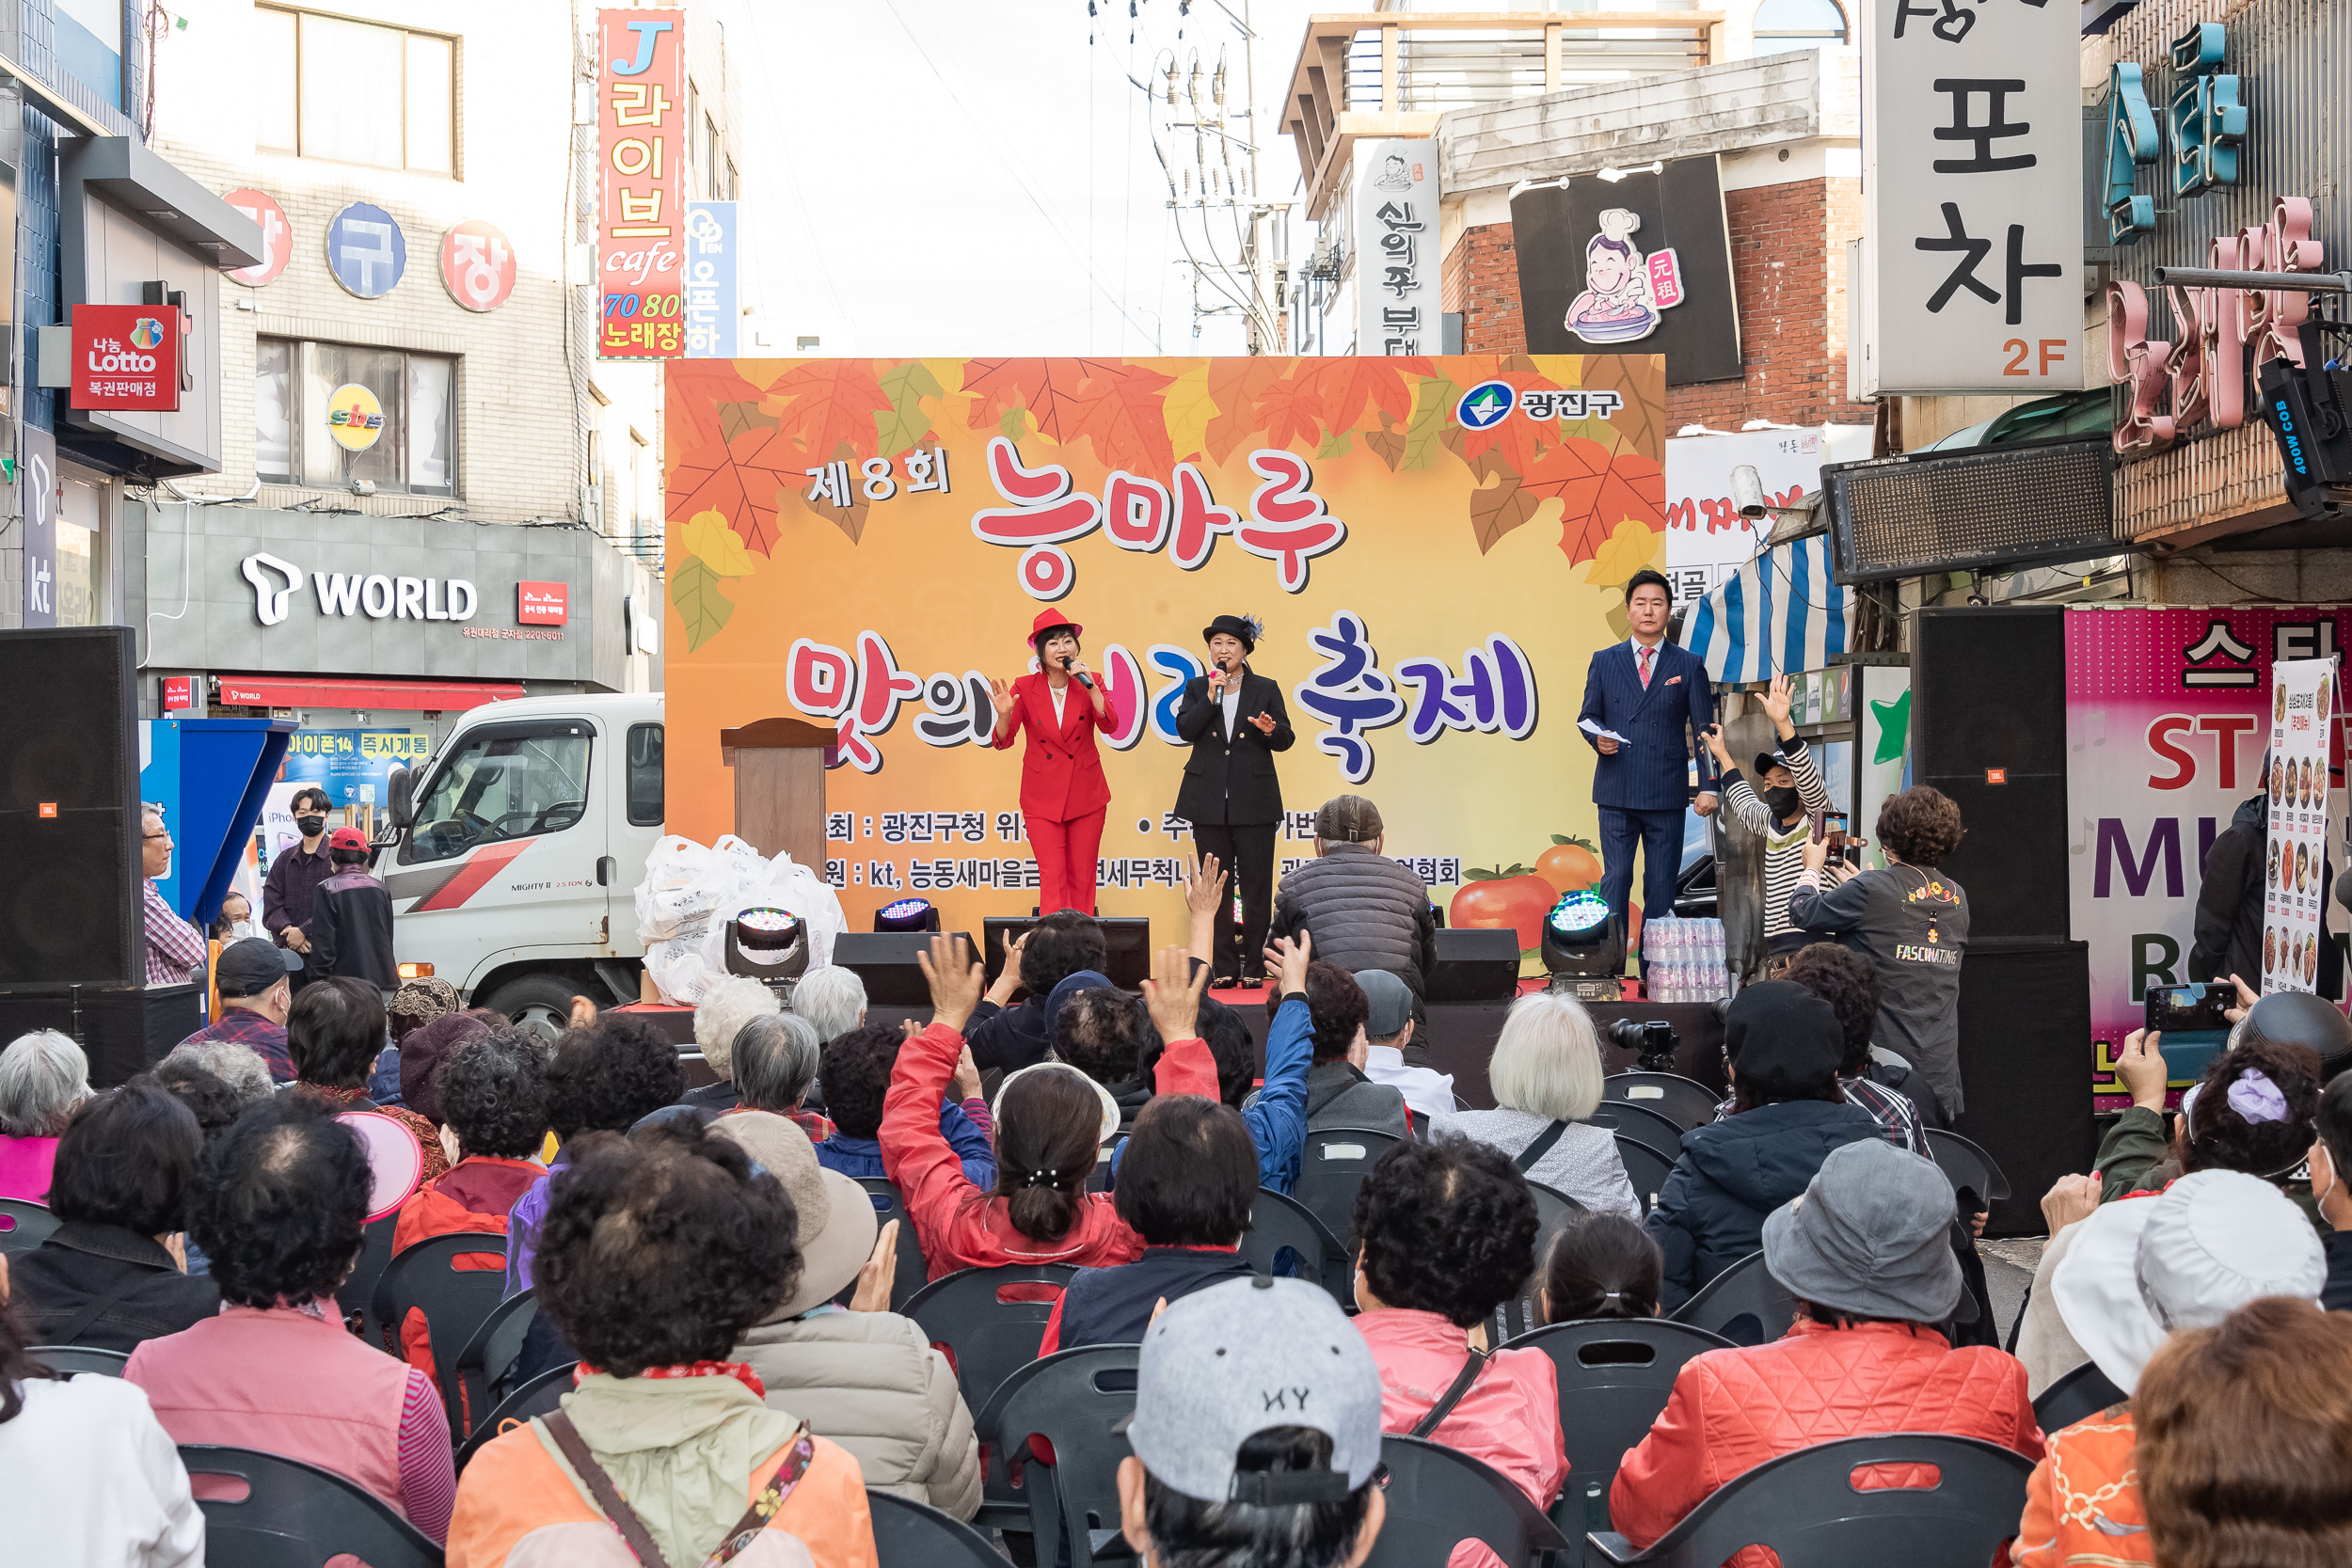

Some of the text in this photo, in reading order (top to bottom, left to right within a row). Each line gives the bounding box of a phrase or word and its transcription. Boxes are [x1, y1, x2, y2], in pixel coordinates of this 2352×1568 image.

[612, 22, 673, 75] J
[612, 83, 671, 238] 라이브
[605, 241, 678, 286] cafe
[1375, 200, 1425, 299] 신의주
[1653, 258, 1677, 302] 元祖
[690, 261, 721, 357] 오픈하
[94, 339, 121, 353] 나눔
[604, 322, 682, 351] 노래장
[88, 351, 156, 372] Lotto
[2002, 338, 2068, 376] 2F
[89, 381, 156, 396] 복권판매점
[1519, 389, 1623, 420] 광진구
[2276, 400, 2306, 474] 400W COB
[972, 437, 1347, 600] 능마루
[31, 556, 51, 614] kt
[312, 570, 478, 622] WORLD
[462, 626, 564, 641] 유원대리점 군자점 2201-6011
[1294, 610, 1539, 784] 축제
[363, 736, 428, 753] 즉시개통
[42, 806, 55, 815] JBL
[268, 812, 295, 823] iPho
[826, 813, 853, 842] 최
[882, 812, 985, 842] 광진구청
[996, 813, 1026, 841] 위
[511, 882, 544, 892] MIGHTY
[871, 861, 901, 889] kt,
[910, 859, 1041, 889] 능동새마을금
[1895, 943, 1958, 965] FASCINATING
